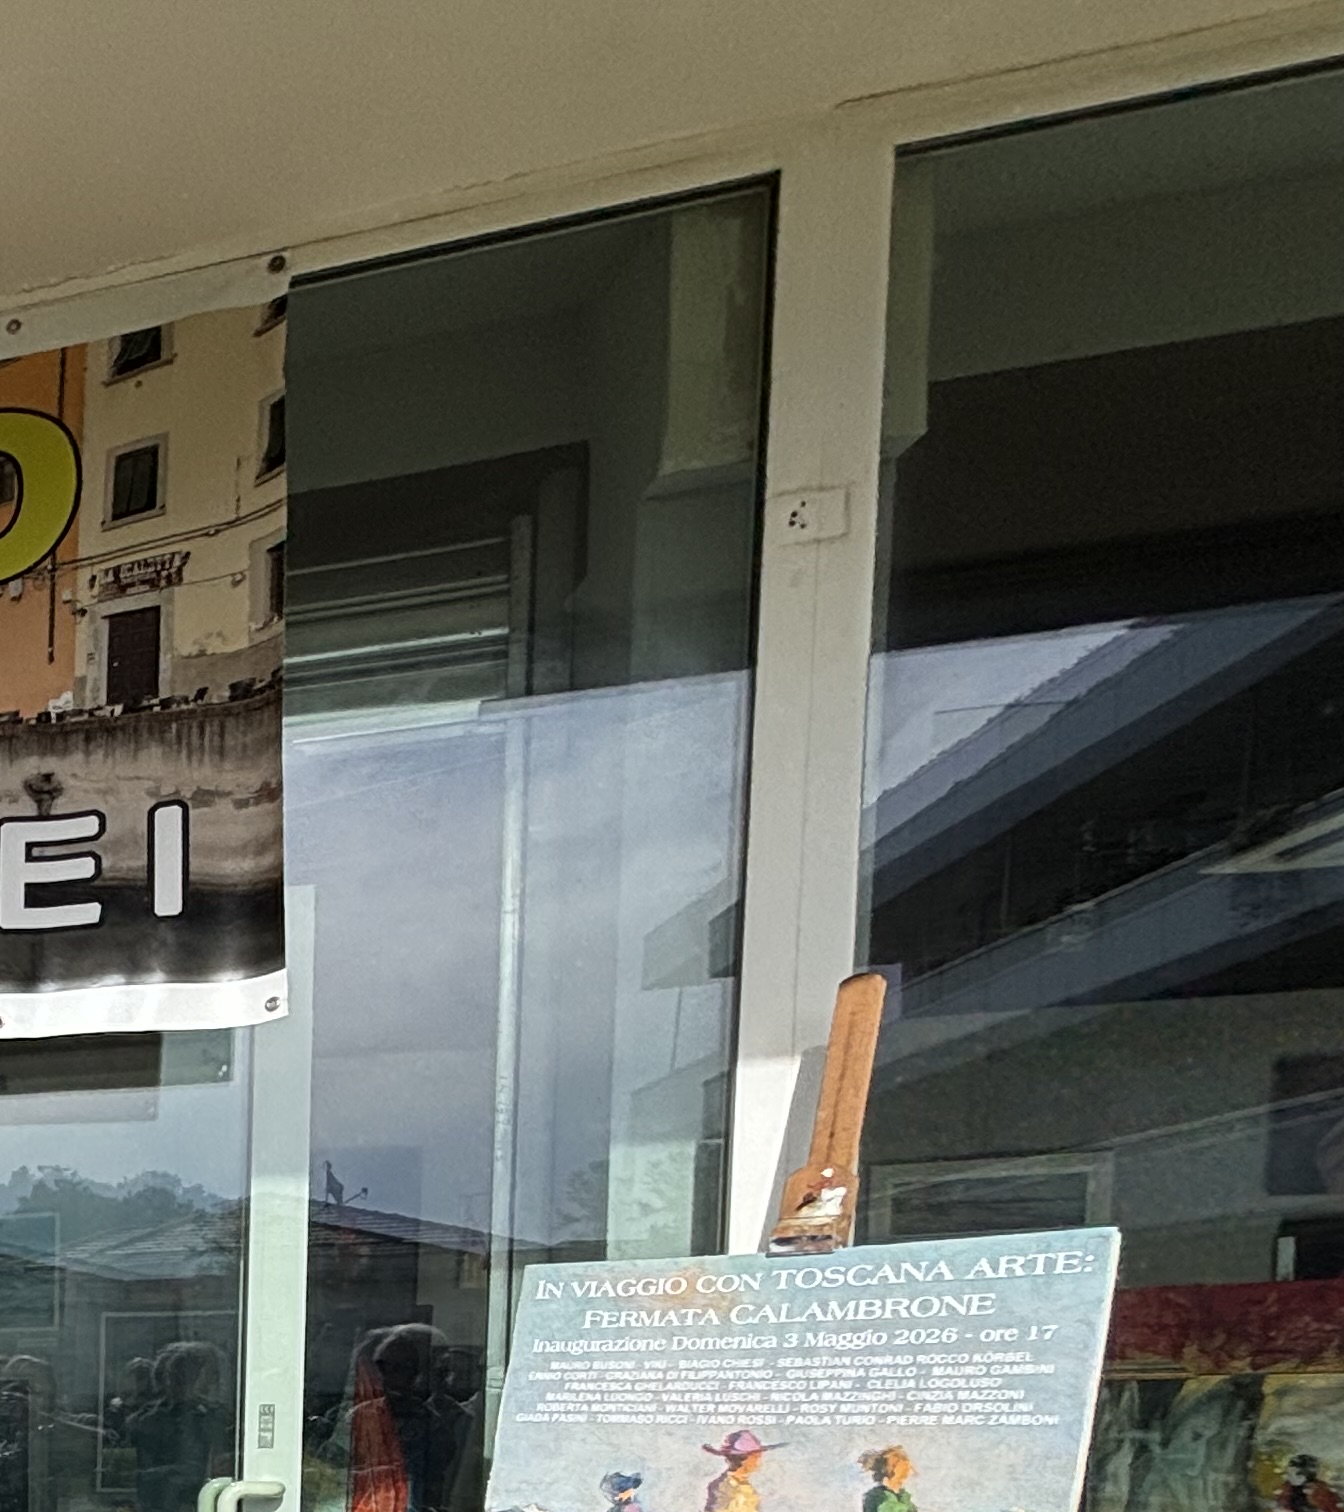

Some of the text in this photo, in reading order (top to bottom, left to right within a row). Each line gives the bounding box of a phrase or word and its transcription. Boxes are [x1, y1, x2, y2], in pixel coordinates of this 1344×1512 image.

[535, 1251, 1095, 1299] IN VIAGGIO CON TOSCANA ARTE:
[581, 1293, 996, 1329] FERMATA CALAMBRONE
[532, 1336, 666, 1355] Inaugurazione
[672, 1333, 777, 1351] Domenica
[783, 1333, 798, 1348] 3
[803, 1328, 888, 1350] Maggio
[893, 1328, 958, 1345] 2026
[979, 1327, 1018, 1342] ore
[1027, 1325, 1059, 1341] 17
[776, 1357, 852, 1368] SEBASTIAN
[853, 1354, 913, 1366] CONRAD
[916, 1353, 969, 1365] ROCCO
[785, 1368, 865, 1379] GIUSEPPINA
[868, 1367, 917, 1378] GALLO
[931, 1365, 987, 1376] MAURO
[564, 1382, 633, 1391] FRANCESCA
[727, 1380, 807, 1390] FRANCESCO
[866, 1379, 916, 1390] CLELIA
[770, 1392, 819, 1402] NICOLA
[957, 1390, 1025, 1400] MAZZONI
[665, 1403, 715, 1413] WALTER
[800, 1403, 836, 1413] ROSY
[737, 1415, 776, 1425] ROSSI
[784, 1415, 832, 1425] PAOLA
[886, 1415, 938, 1425] PIERRE
